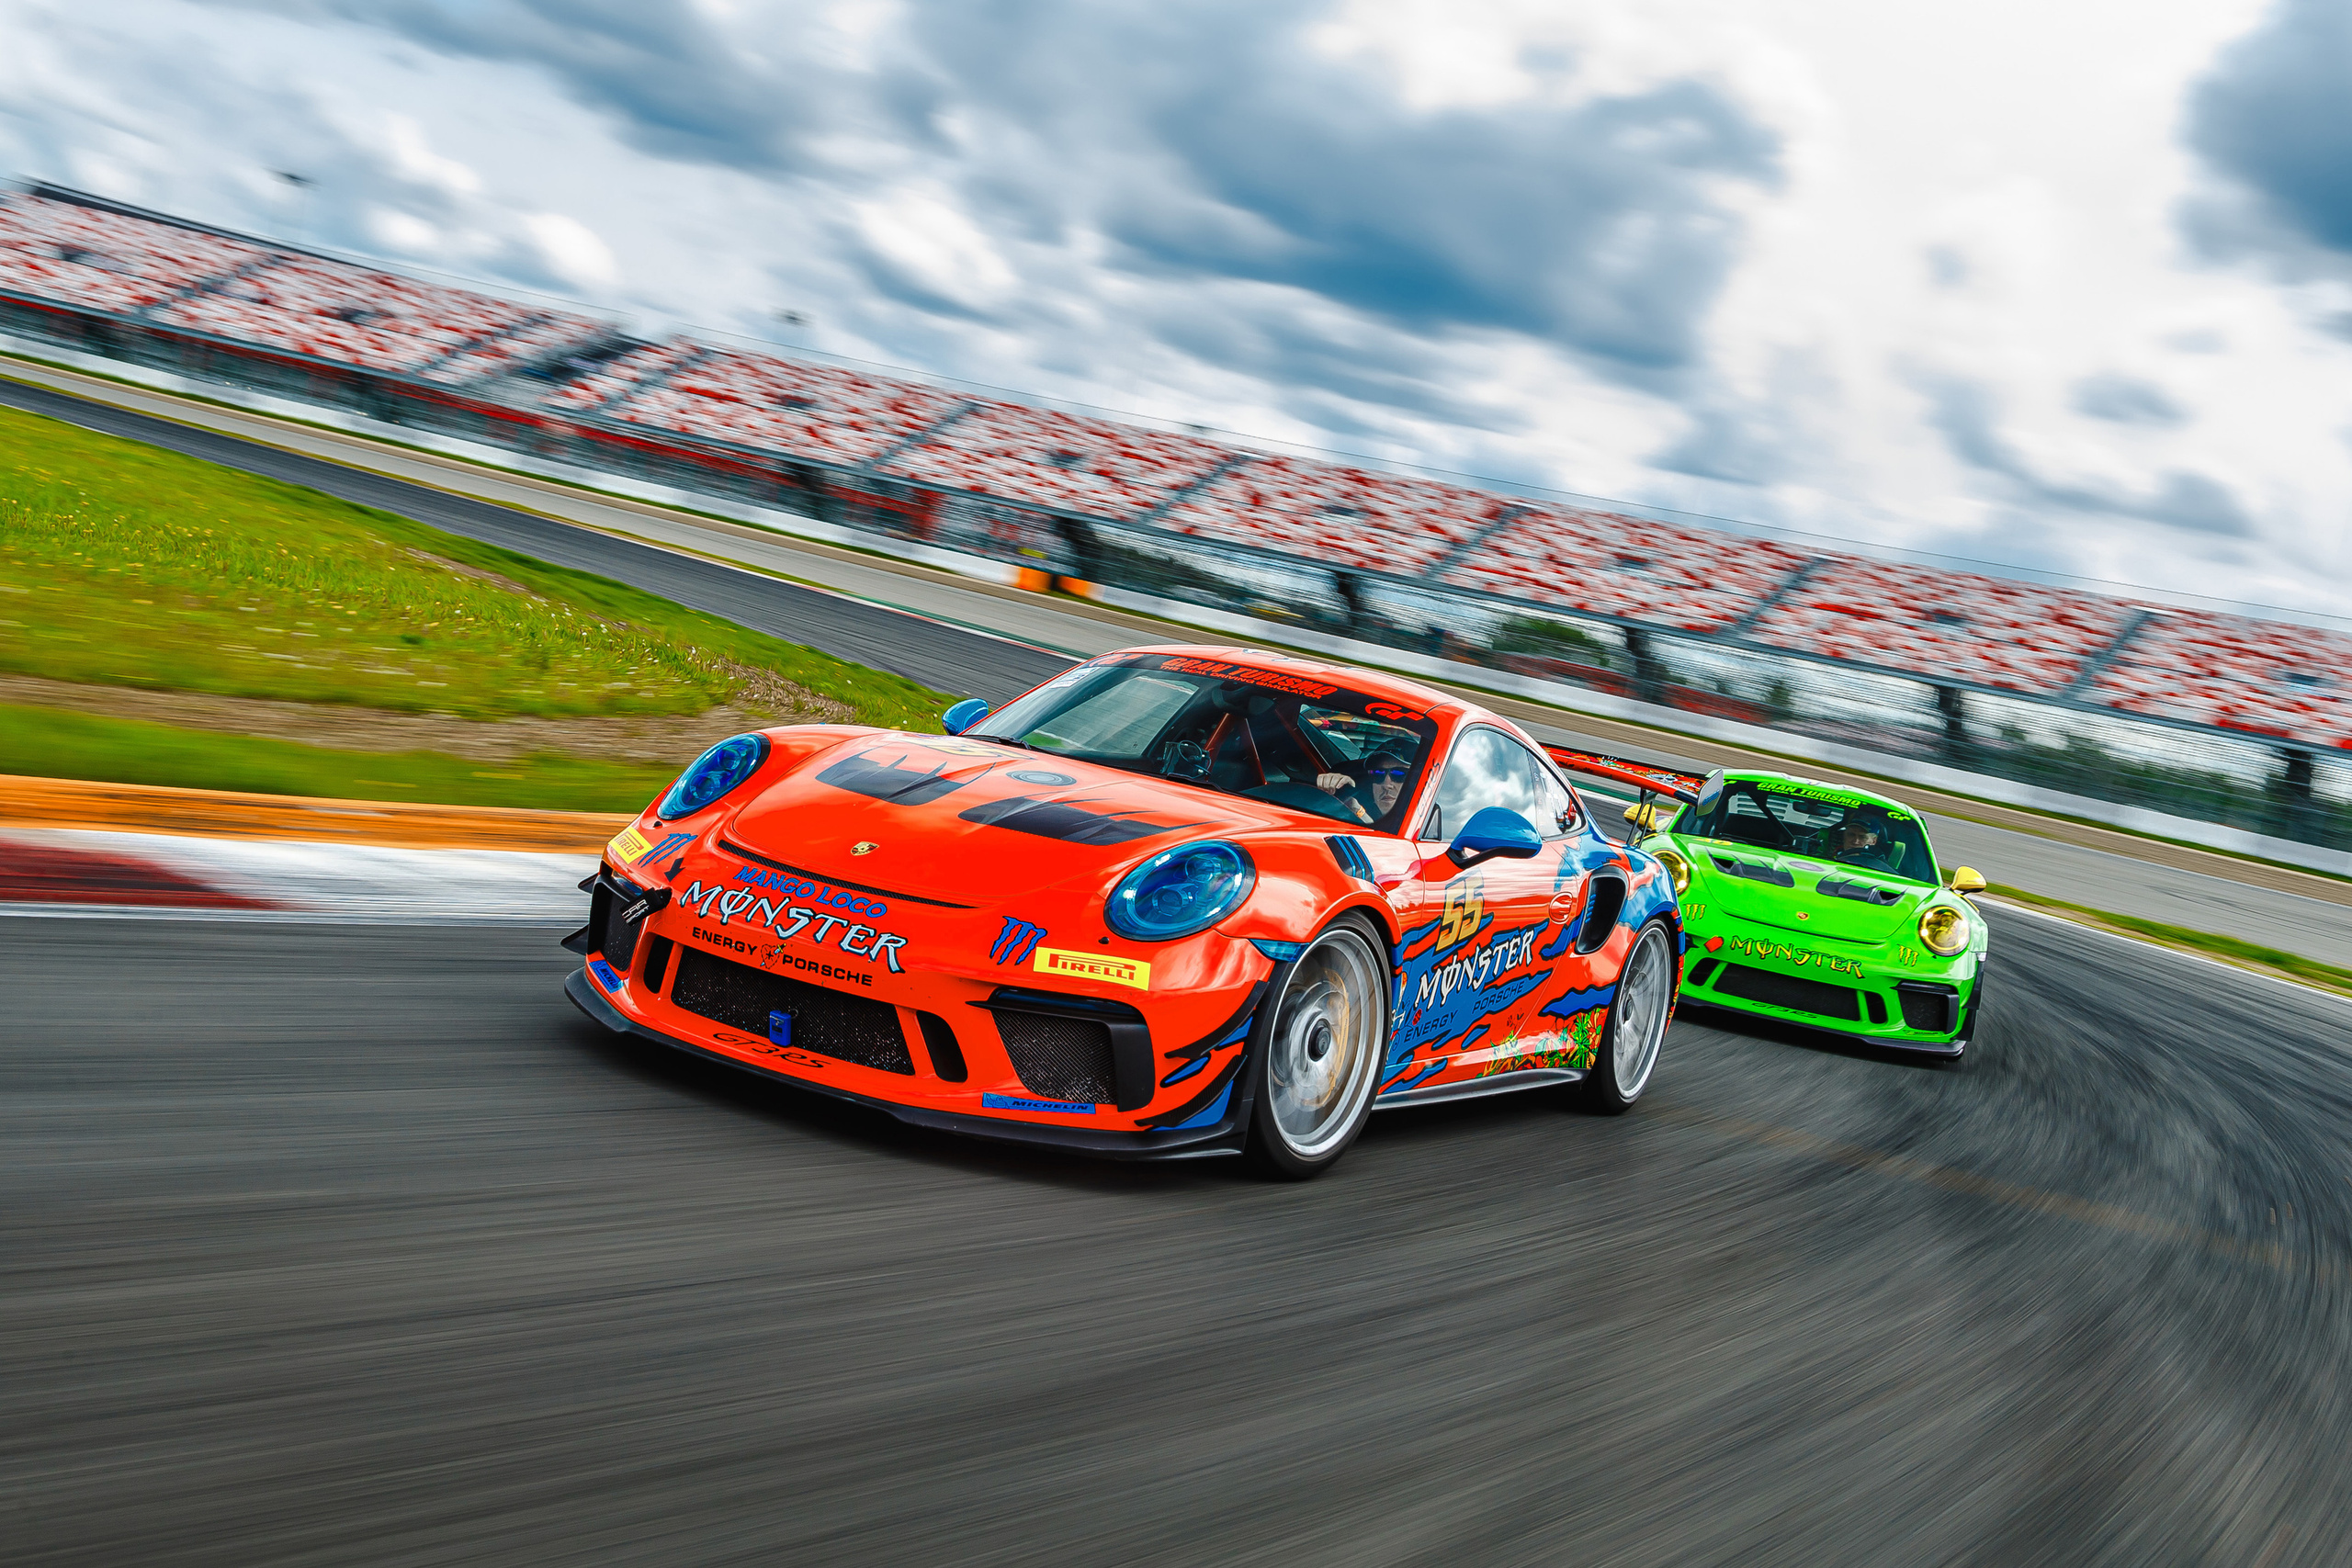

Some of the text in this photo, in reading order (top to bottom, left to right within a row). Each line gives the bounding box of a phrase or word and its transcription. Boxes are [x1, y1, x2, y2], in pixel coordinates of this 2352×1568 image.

[1161, 658, 1339, 695] GRAN TURISMO
[1209, 671, 1255, 684] DRIVING
[1255, 681, 1322, 700] SIMULATOR
[1757, 782, 1797, 793] GRAN
[1800, 789, 1861, 807] TURISMO
[614, 830, 645, 857] PIRELLI
[733, 865, 888, 919] MANGO LOCO
[621, 898, 648, 919] CAR
[1435, 867, 1486, 953] 55
[692, 926, 873, 987] ENERGY PORSCHE
[1048, 953, 1137, 981] PIRELLI
[1472, 981, 1526, 1014] PORSCHE
[1404, 1010, 1459, 1043] ENERGY
[1012, 1100, 1089, 1111] MICHELIN
